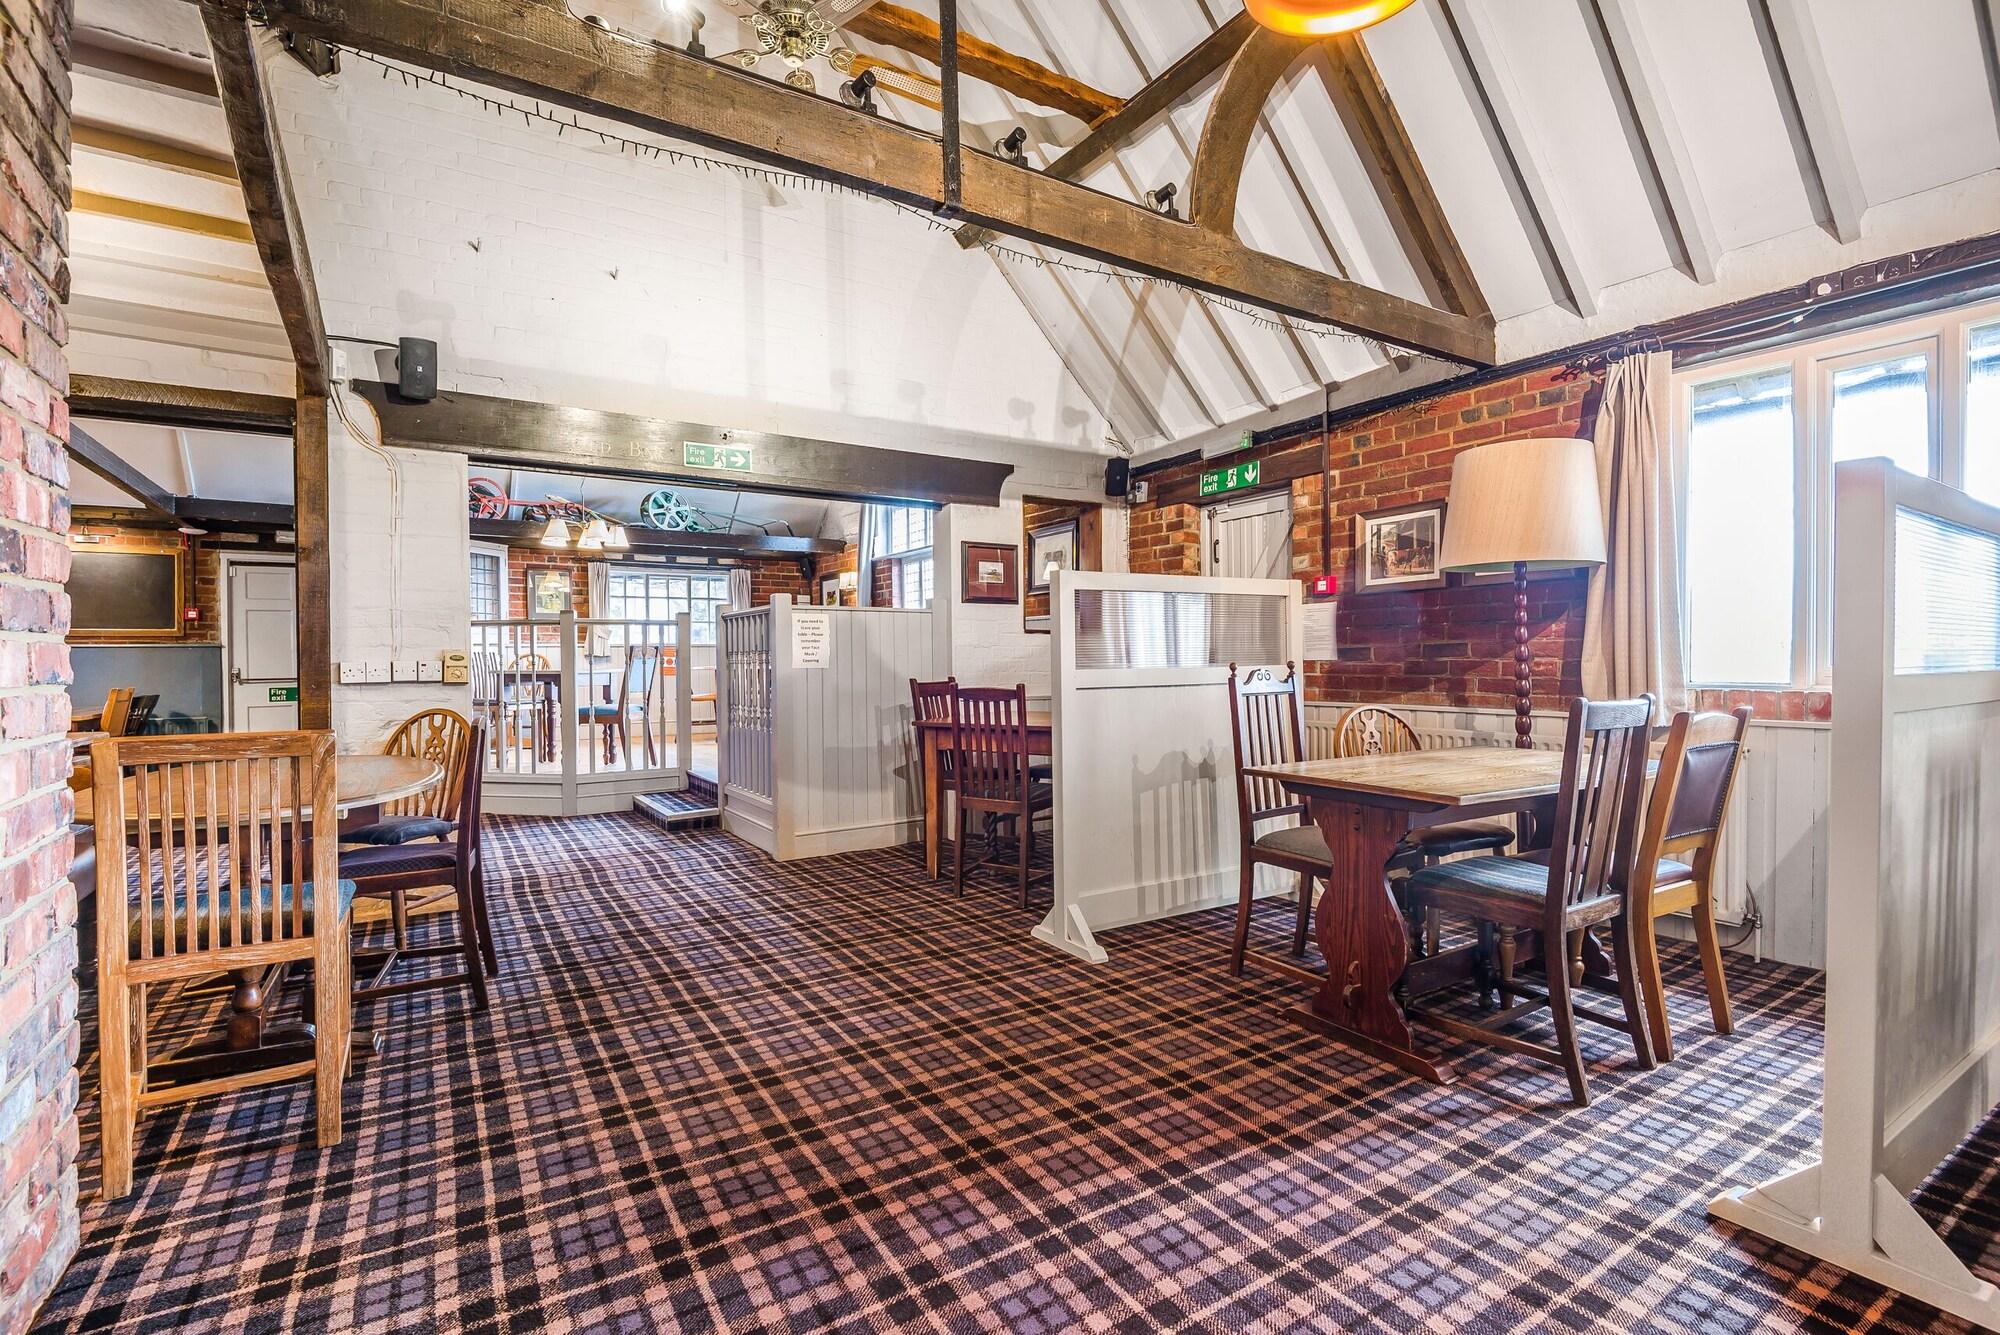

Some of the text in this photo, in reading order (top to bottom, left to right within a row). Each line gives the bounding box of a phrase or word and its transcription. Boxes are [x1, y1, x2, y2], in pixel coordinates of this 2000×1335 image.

[689, 447, 705, 455] Fire
[689, 456, 705, 464] exit
[1203, 474, 1218, 484] Fire
[1203, 483, 1218, 493] exit
